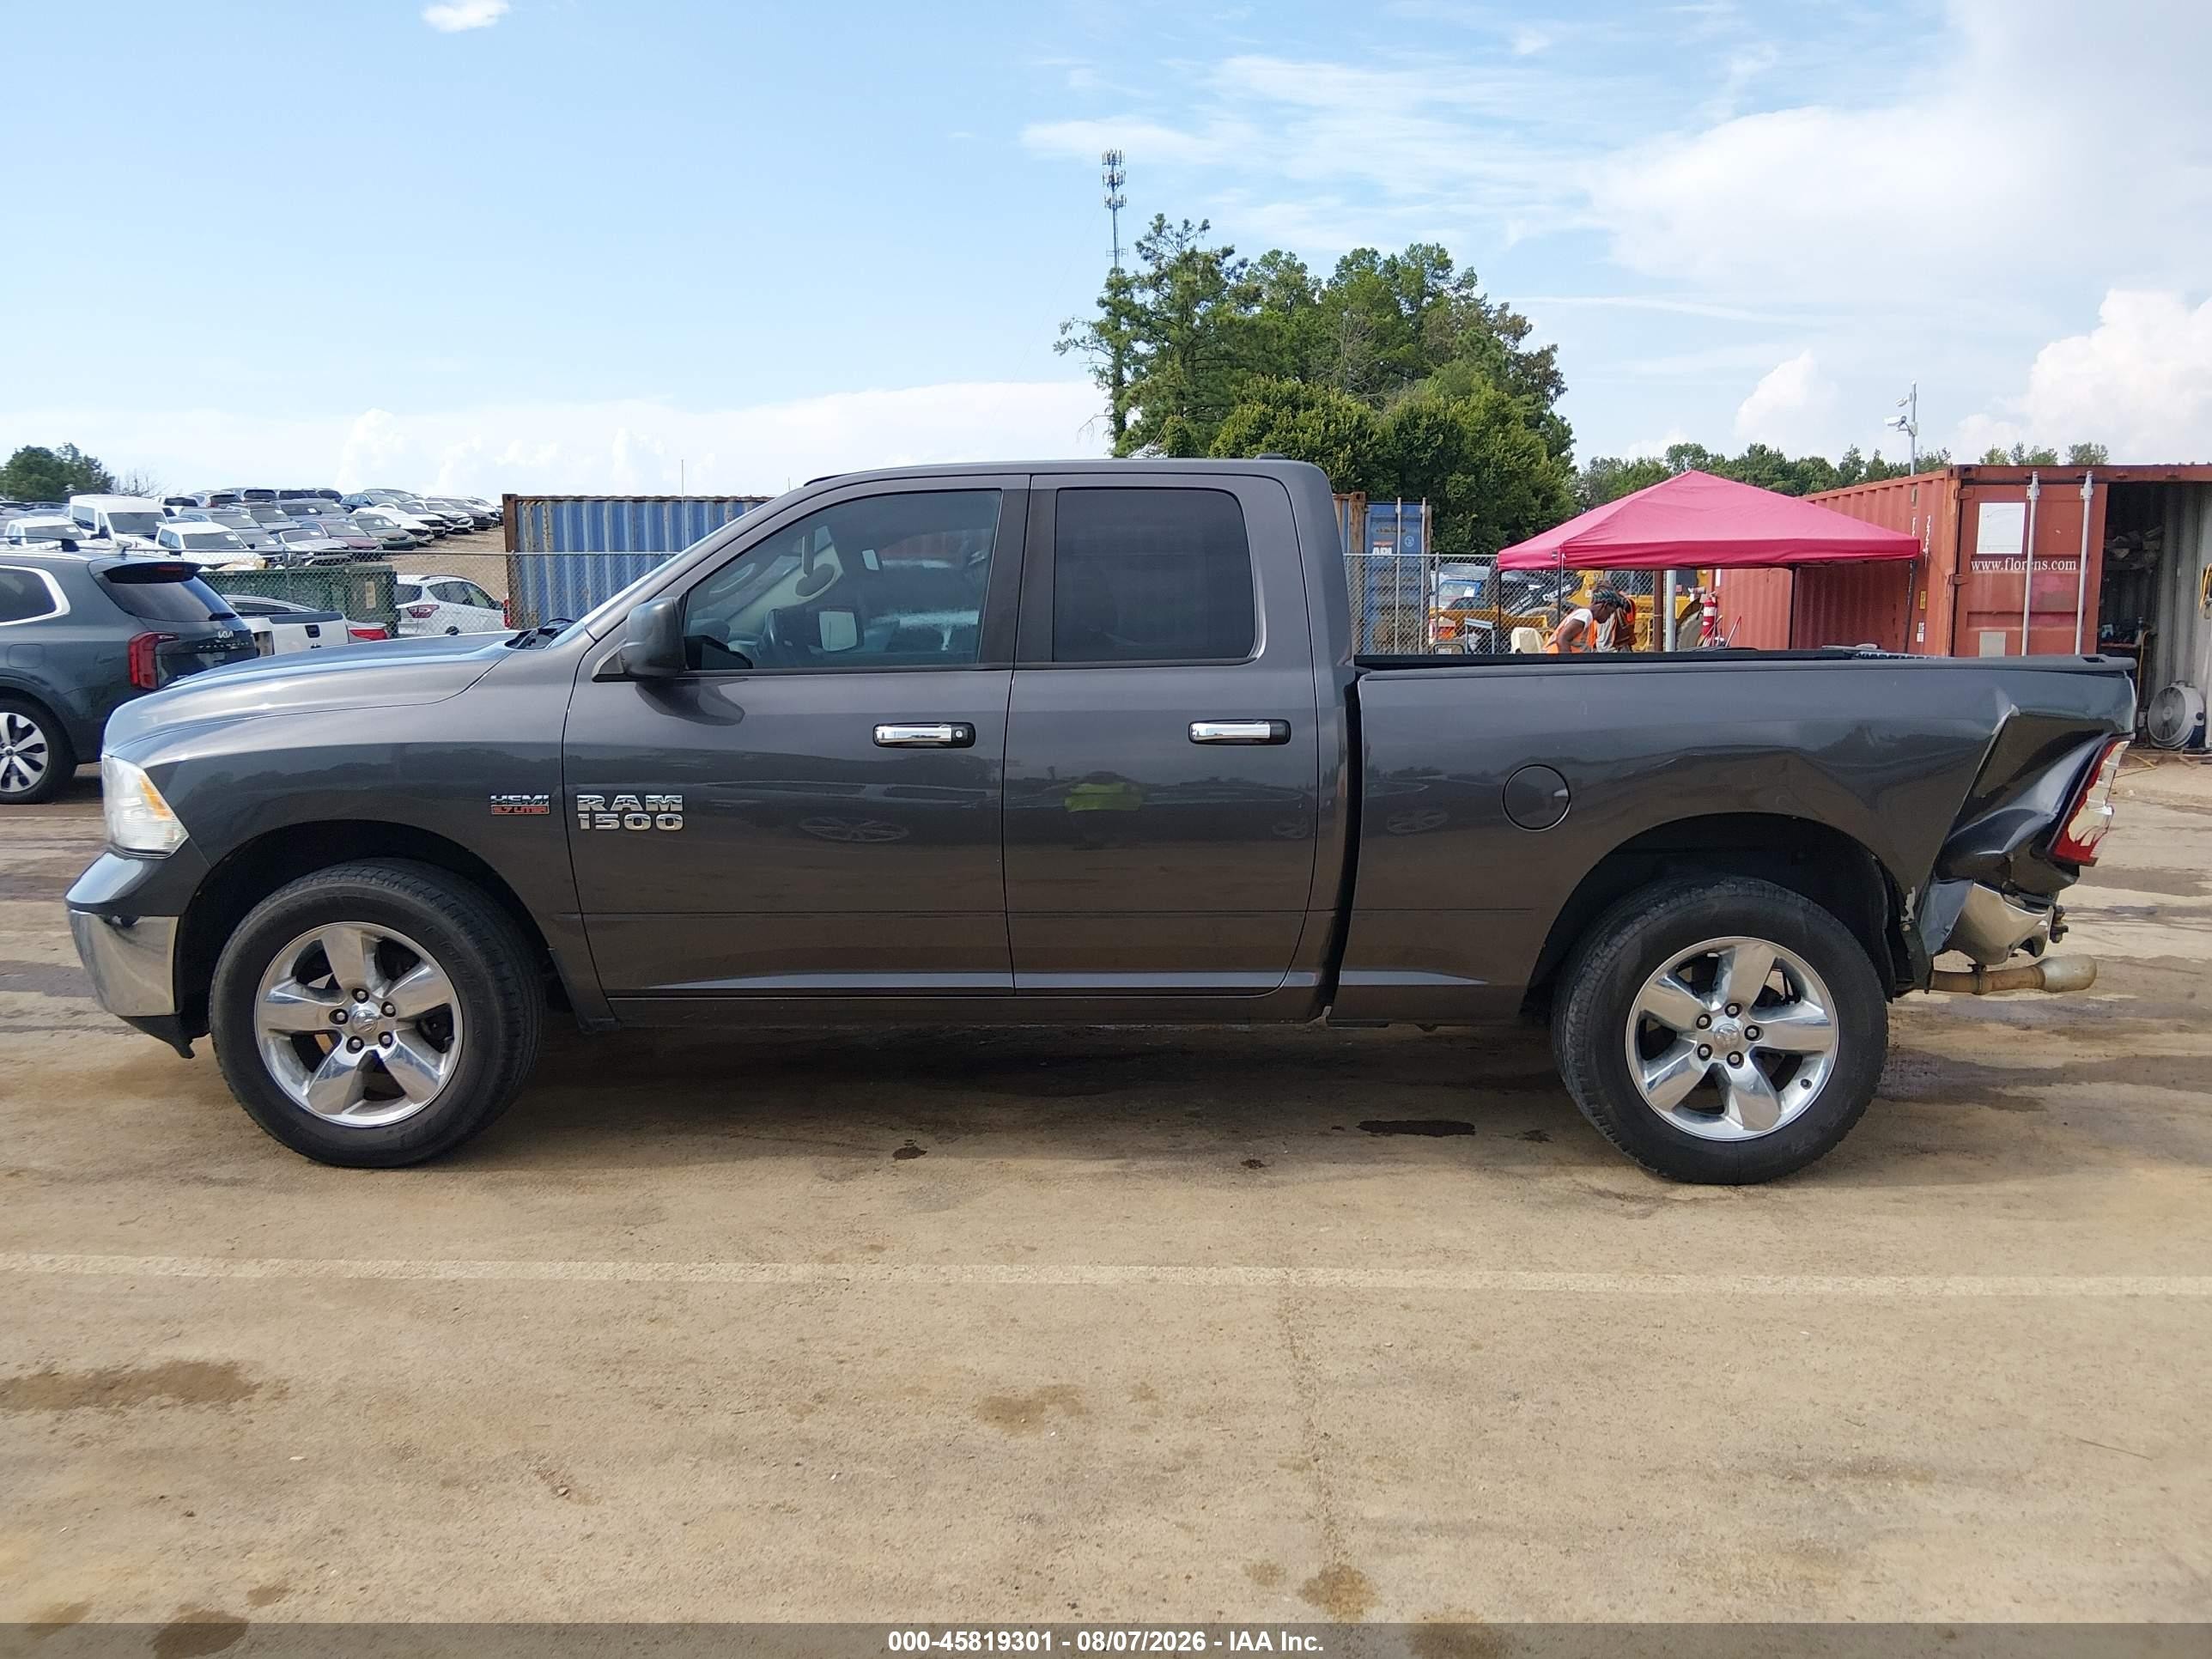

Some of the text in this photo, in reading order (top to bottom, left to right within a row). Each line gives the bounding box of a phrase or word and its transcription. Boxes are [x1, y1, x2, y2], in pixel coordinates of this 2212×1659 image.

[1971, 557, 2076, 571] www.florns.com
[1542, 584, 1571, 602] DEERE
[491, 794, 550, 805] HEMI
[576, 794, 684, 811] RAM
[578, 813, 684, 830] 1500
